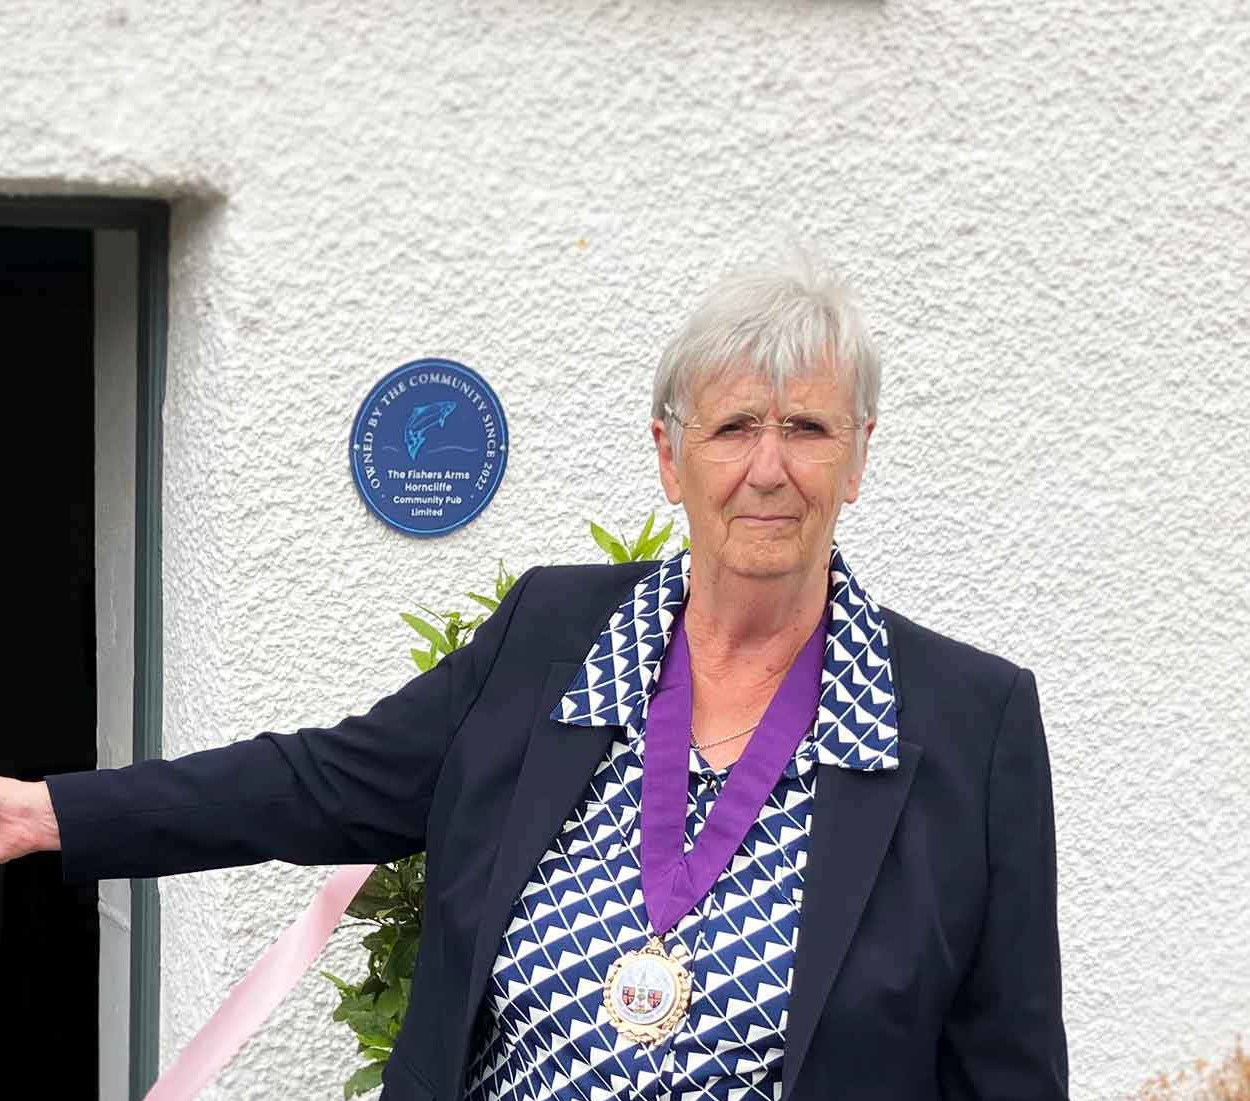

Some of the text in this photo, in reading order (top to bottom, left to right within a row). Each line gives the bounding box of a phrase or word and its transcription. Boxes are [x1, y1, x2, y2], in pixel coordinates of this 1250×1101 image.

[363, 373, 496, 491] OWNED BY THE COMMUNITY SINCE 2022
[388, 470, 470, 480] The Fishers Arms
[405, 482, 452, 492] Horncliffe
[393, 495, 462, 506] Community Pub
[411, 508, 443, 517] Limited
